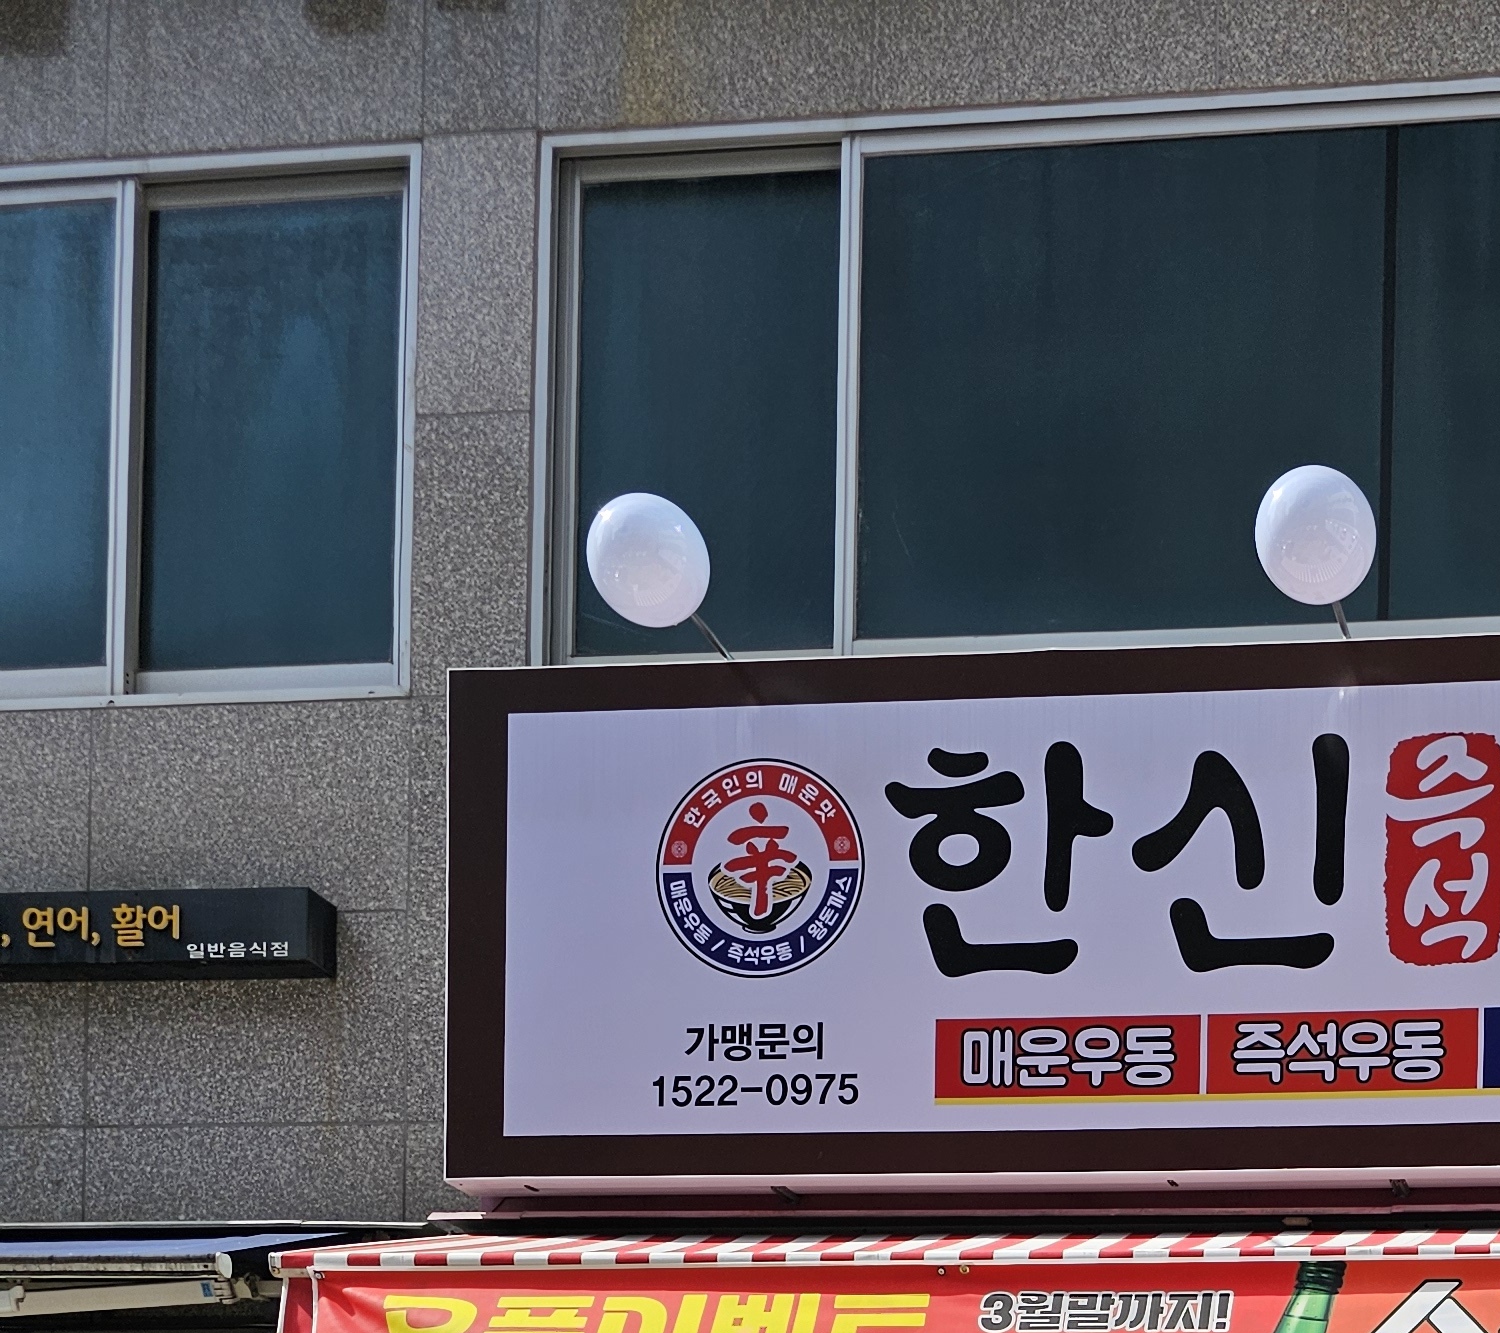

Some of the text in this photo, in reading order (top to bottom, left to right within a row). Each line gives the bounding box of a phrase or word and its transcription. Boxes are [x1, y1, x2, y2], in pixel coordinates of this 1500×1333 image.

[683, 769, 837, 829] 한국인의 매운맛
[884, 732, 1352, 978] 한신
[111, 903, 181, 948] 활어
[186, 941, 289, 960] 일반음식점
[684, 1020, 827, 1064] 가맹문의
[961, 1025, 1178, 1090] 매운우동
[1233, 1018, 1447, 1084] 즉석우동
[652, 1072, 860, 1109] 1522-0975
